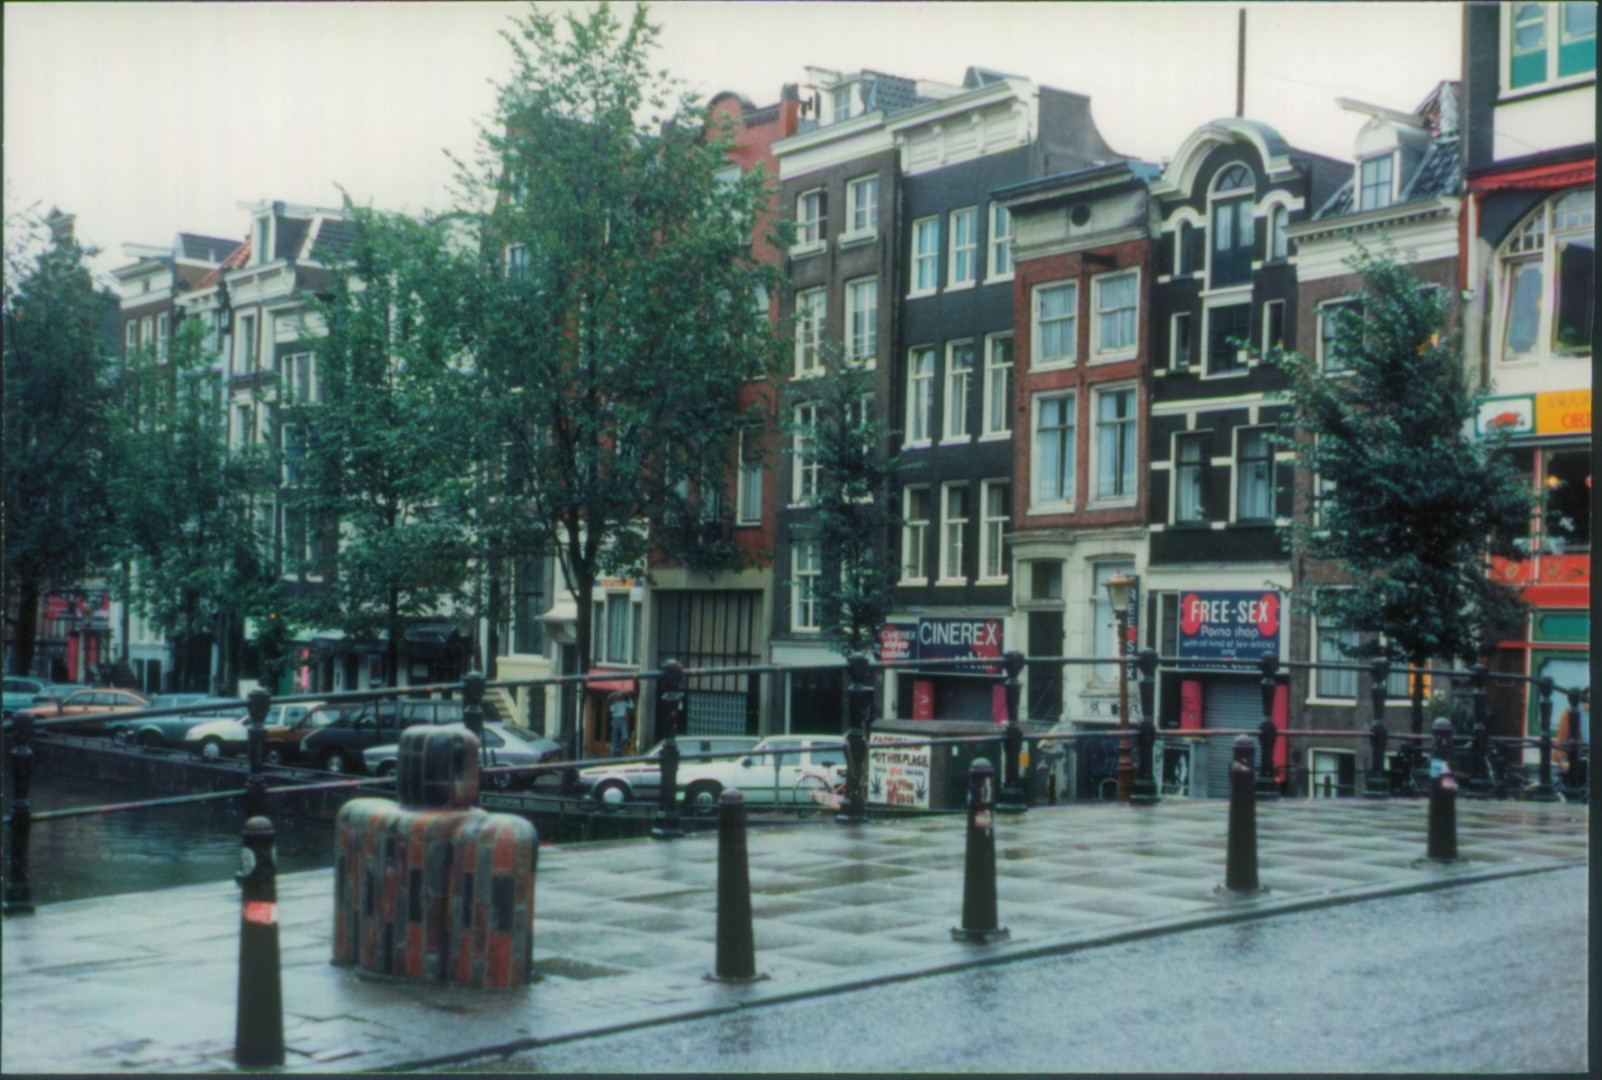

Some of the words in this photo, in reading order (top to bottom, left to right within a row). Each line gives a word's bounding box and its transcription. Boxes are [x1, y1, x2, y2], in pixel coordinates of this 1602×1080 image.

[1190, 600, 1268, 623] FREE-SEX
[881, 630, 916, 640] CINEREX
[920, 621, 997, 645] CINEREX
[1201, 624, 1232, 636] Porno
[1234, 626, 1259, 639] shop
